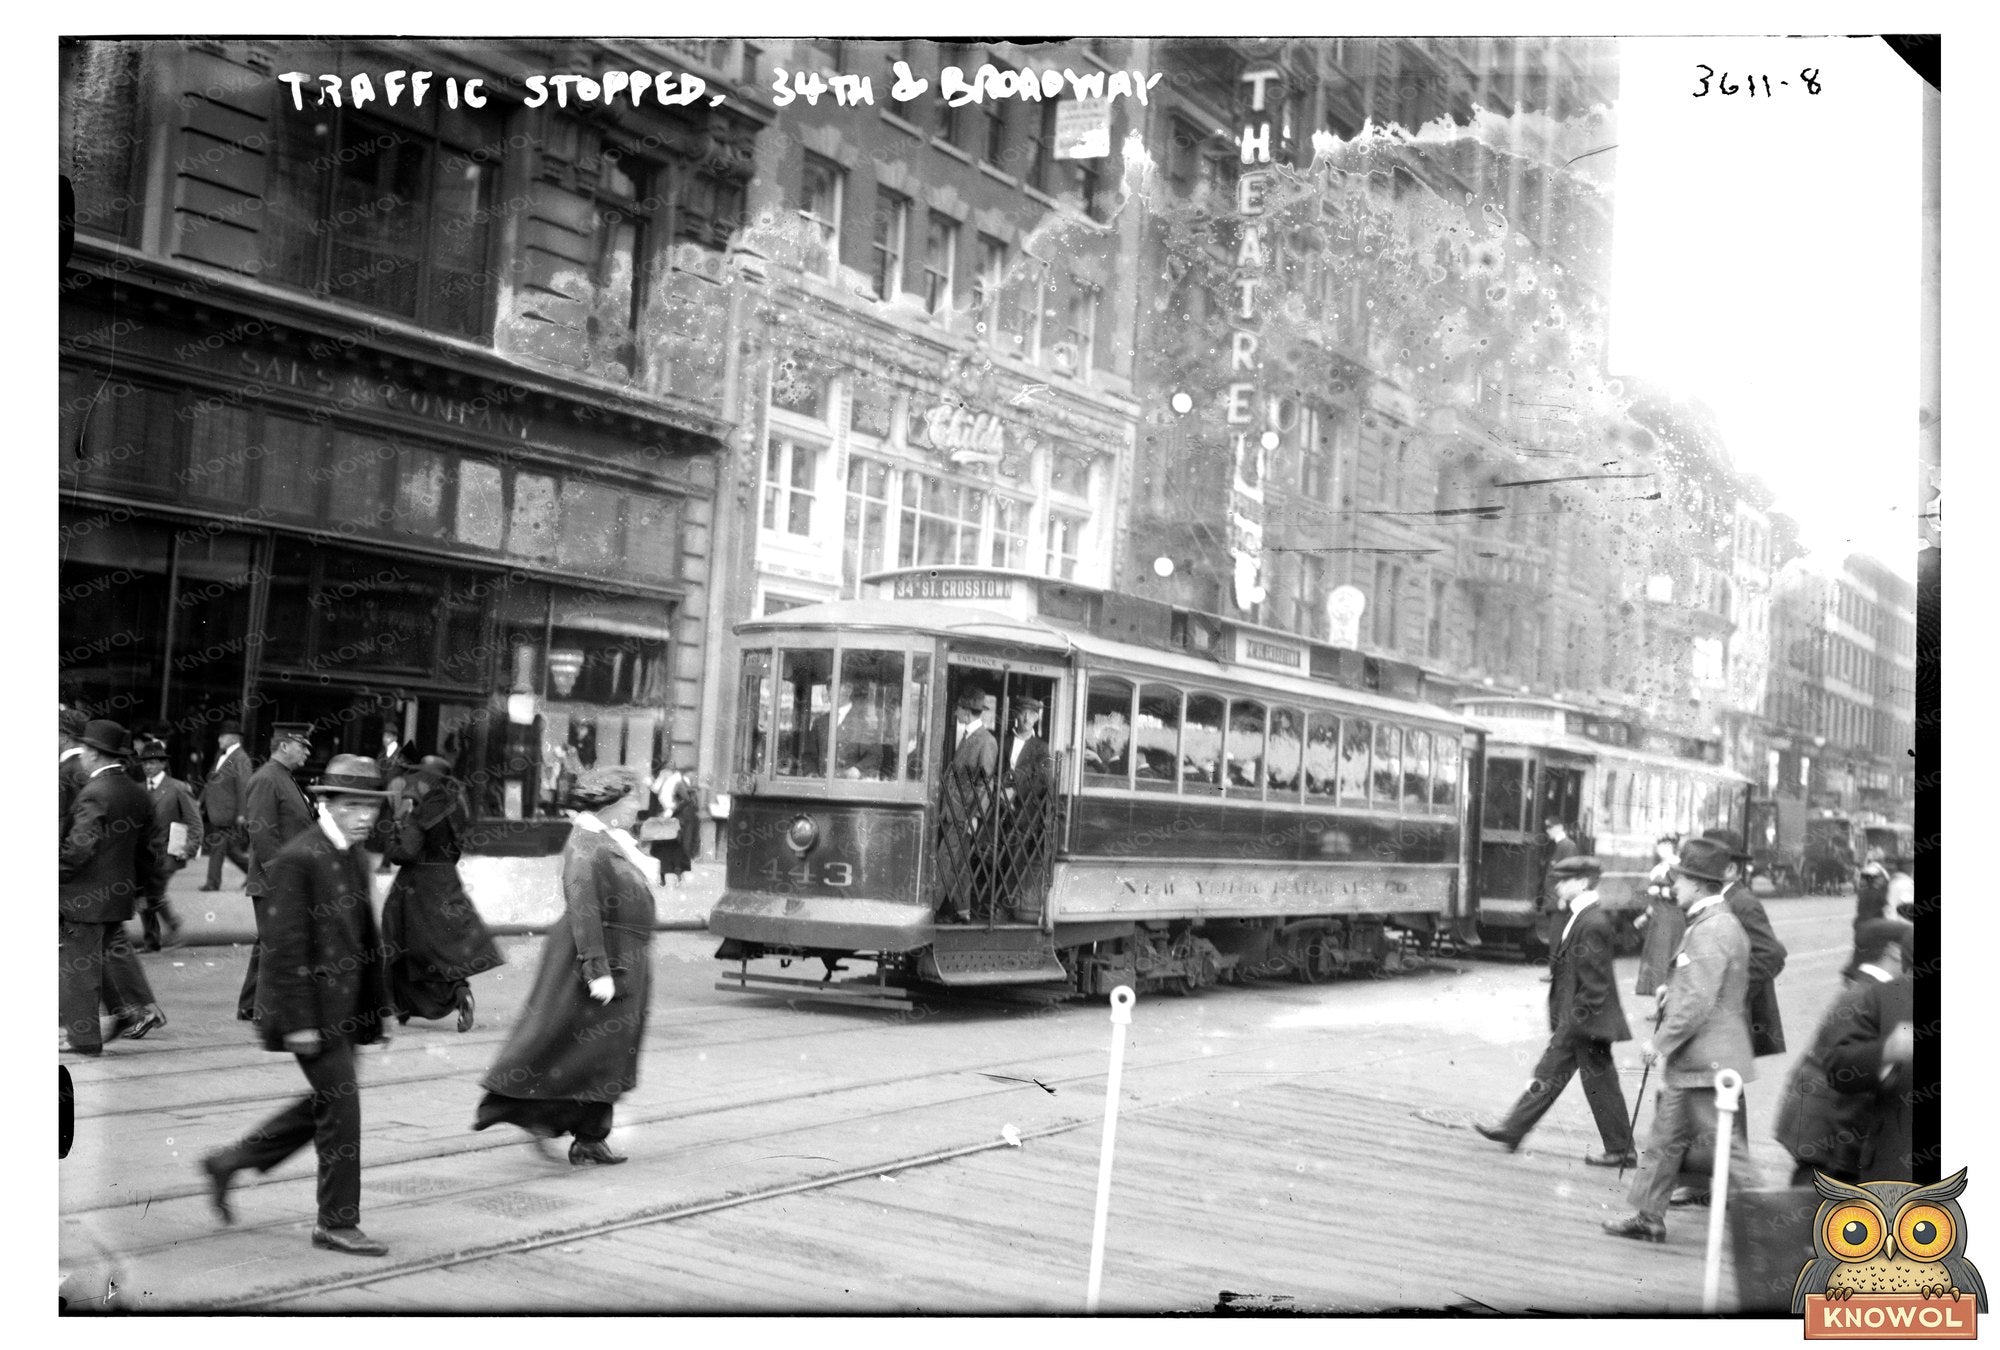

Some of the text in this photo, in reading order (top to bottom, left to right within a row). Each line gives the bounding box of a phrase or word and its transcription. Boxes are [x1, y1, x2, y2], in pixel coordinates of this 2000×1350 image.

[1227, 69, 1280, 425] THEATRE
[942, 579, 1011, 598] CROSSTOWN
[760, 858, 852, 887] 443
